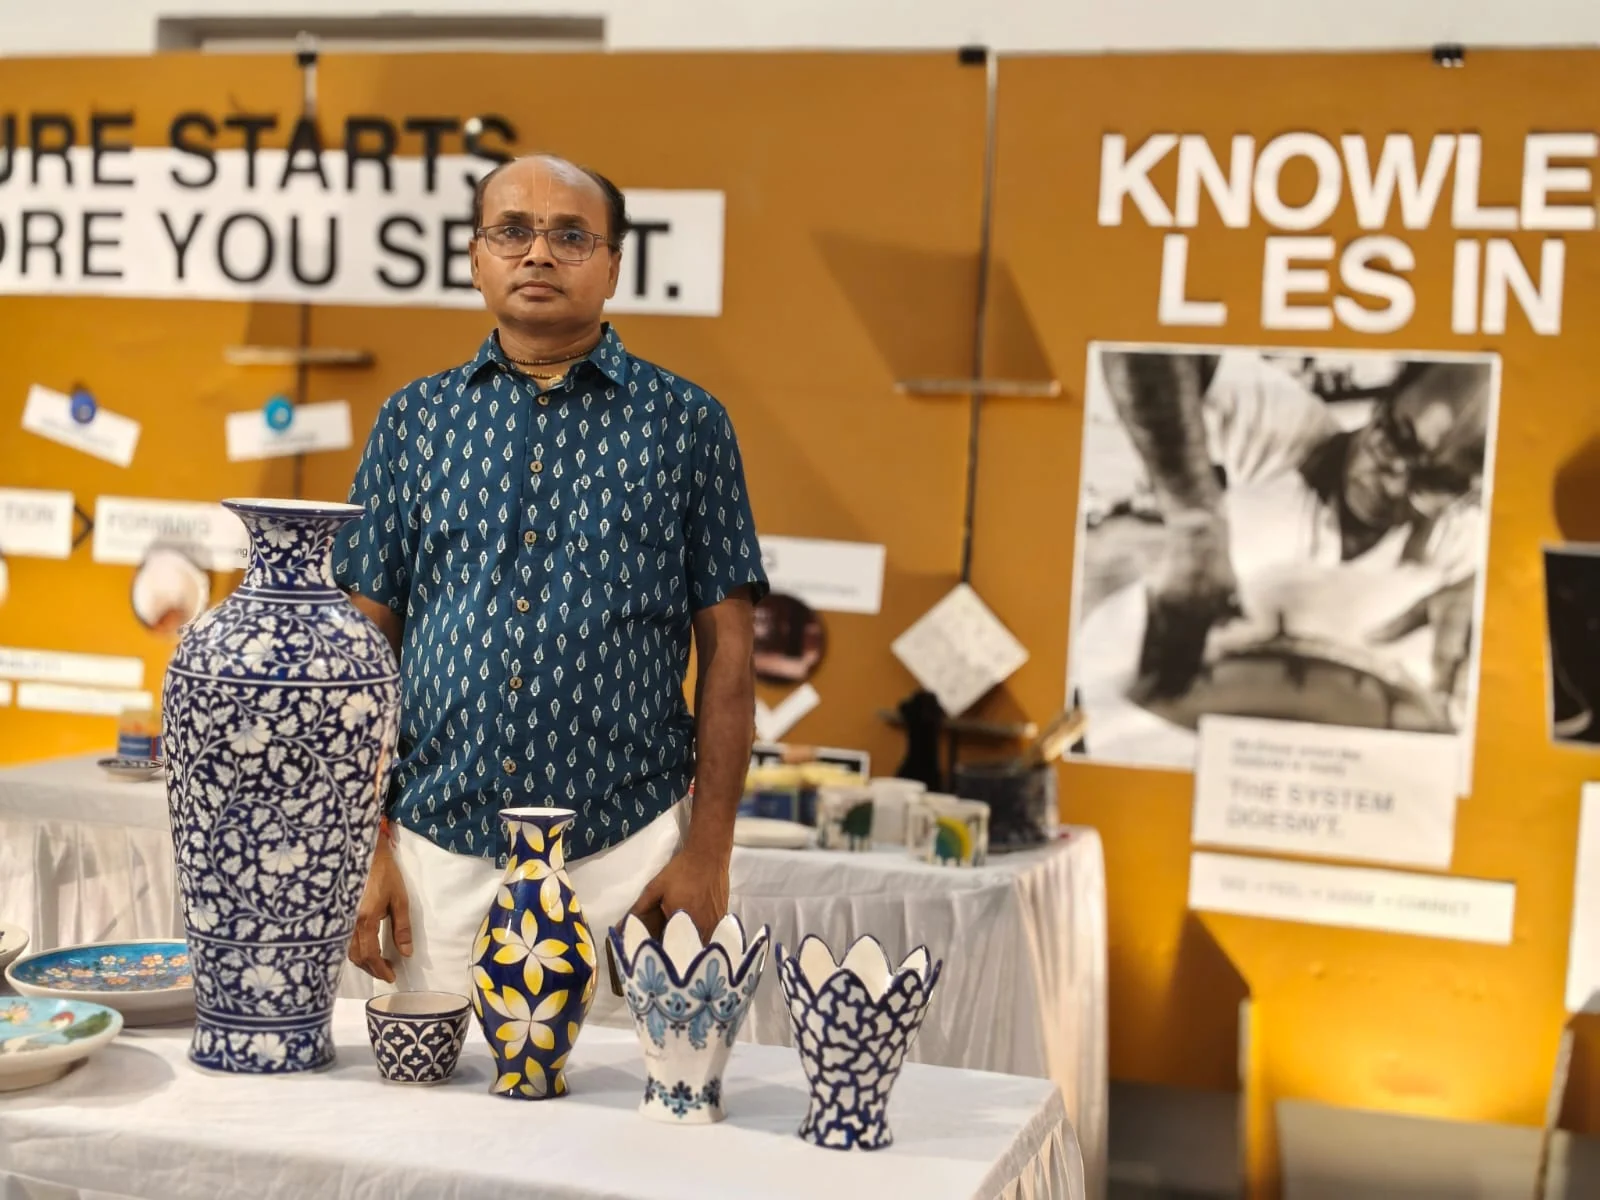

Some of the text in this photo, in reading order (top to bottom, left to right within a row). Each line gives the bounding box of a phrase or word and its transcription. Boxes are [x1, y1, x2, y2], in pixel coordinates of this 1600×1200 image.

[167, 114, 518, 193] STARTS
[0, 210, 125, 277] RE
[159, 211, 337, 287] YOU
[376, 213, 478, 291] SE
[1450, 237, 1567, 336] IN
[1288, 783, 1396, 815] SYSTEM
